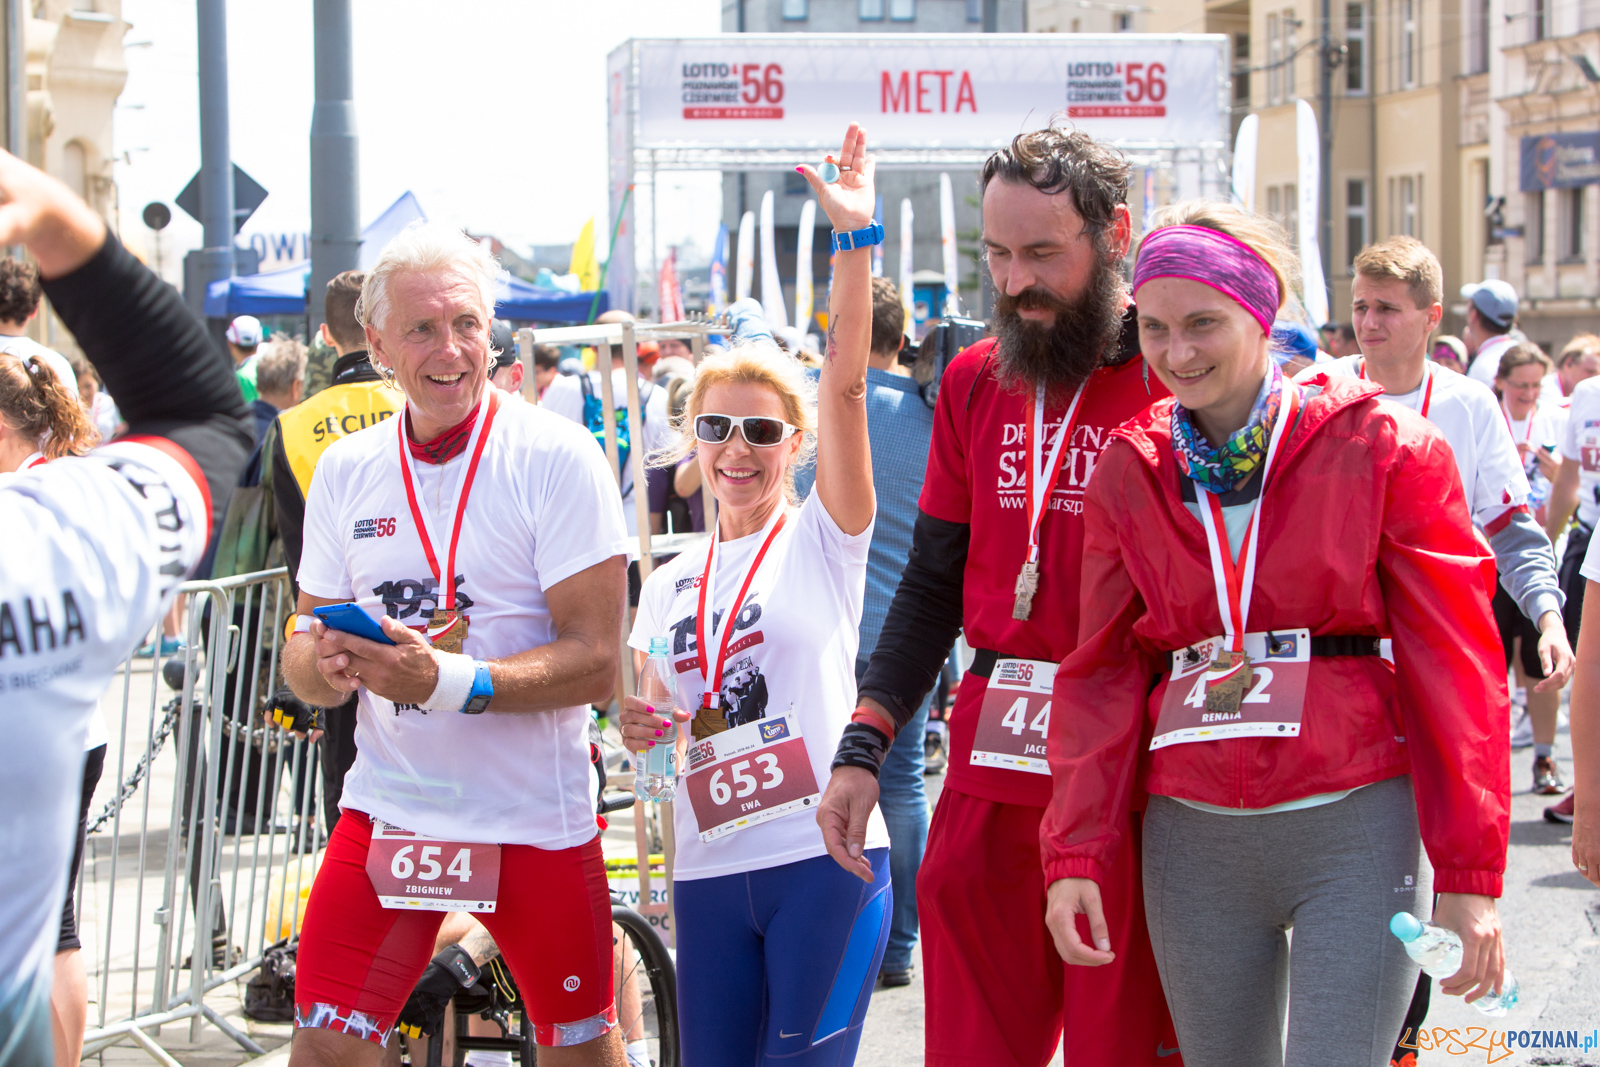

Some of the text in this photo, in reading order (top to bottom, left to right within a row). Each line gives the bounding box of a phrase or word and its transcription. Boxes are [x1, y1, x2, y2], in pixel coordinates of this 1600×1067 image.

[682, 63, 729, 78] LOTTO
[1067, 62, 1114, 77] LOTTO
[881, 70, 978, 113] META
[354, 519, 374, 528] LOTTO
[1183, 666, 1274, 709] 42
[709, 752, 785, 806] 653
[741, 799, 762, 812] EWA
[390, 844, 473, 883] 654
[405, 884, 453, 896] ZBIGNIEW
